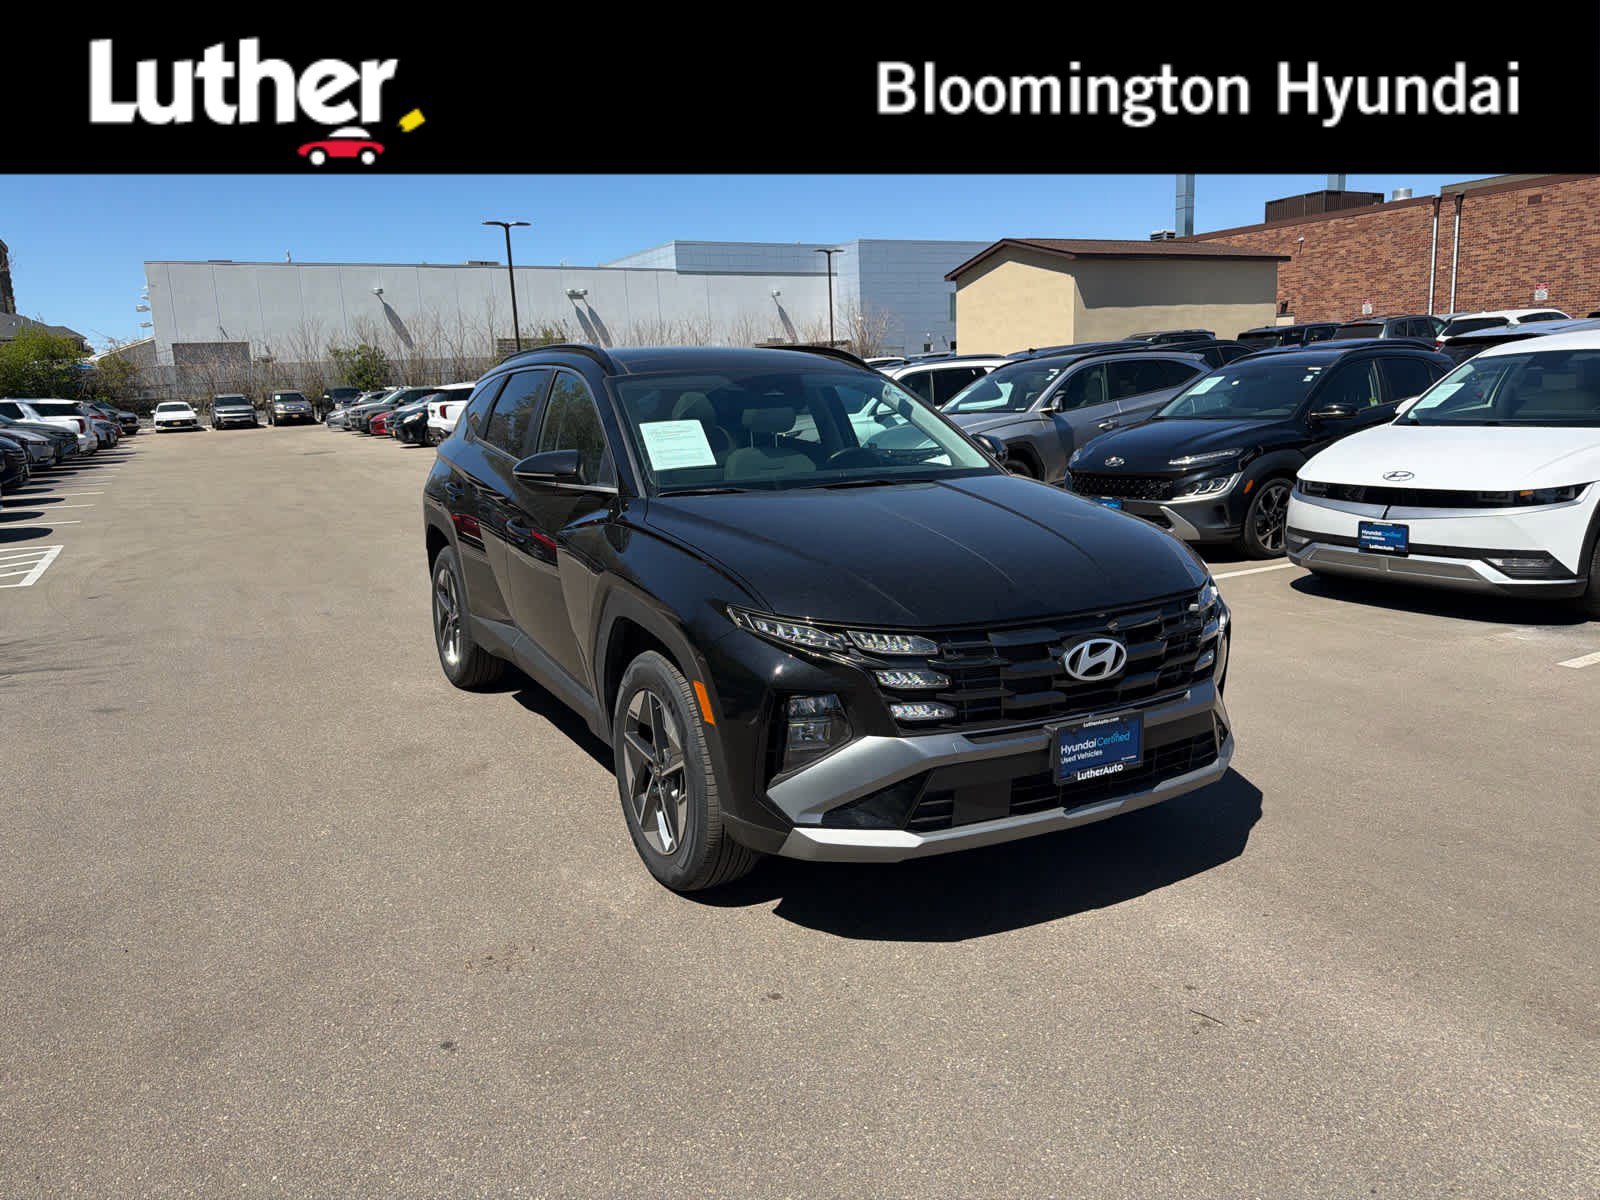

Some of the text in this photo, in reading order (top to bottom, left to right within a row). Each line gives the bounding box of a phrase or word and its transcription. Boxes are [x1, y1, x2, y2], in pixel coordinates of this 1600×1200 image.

[1060, 749, 1104, 765] Used Vehicles
[1077, 763, 1124, 781] LutherAuto
